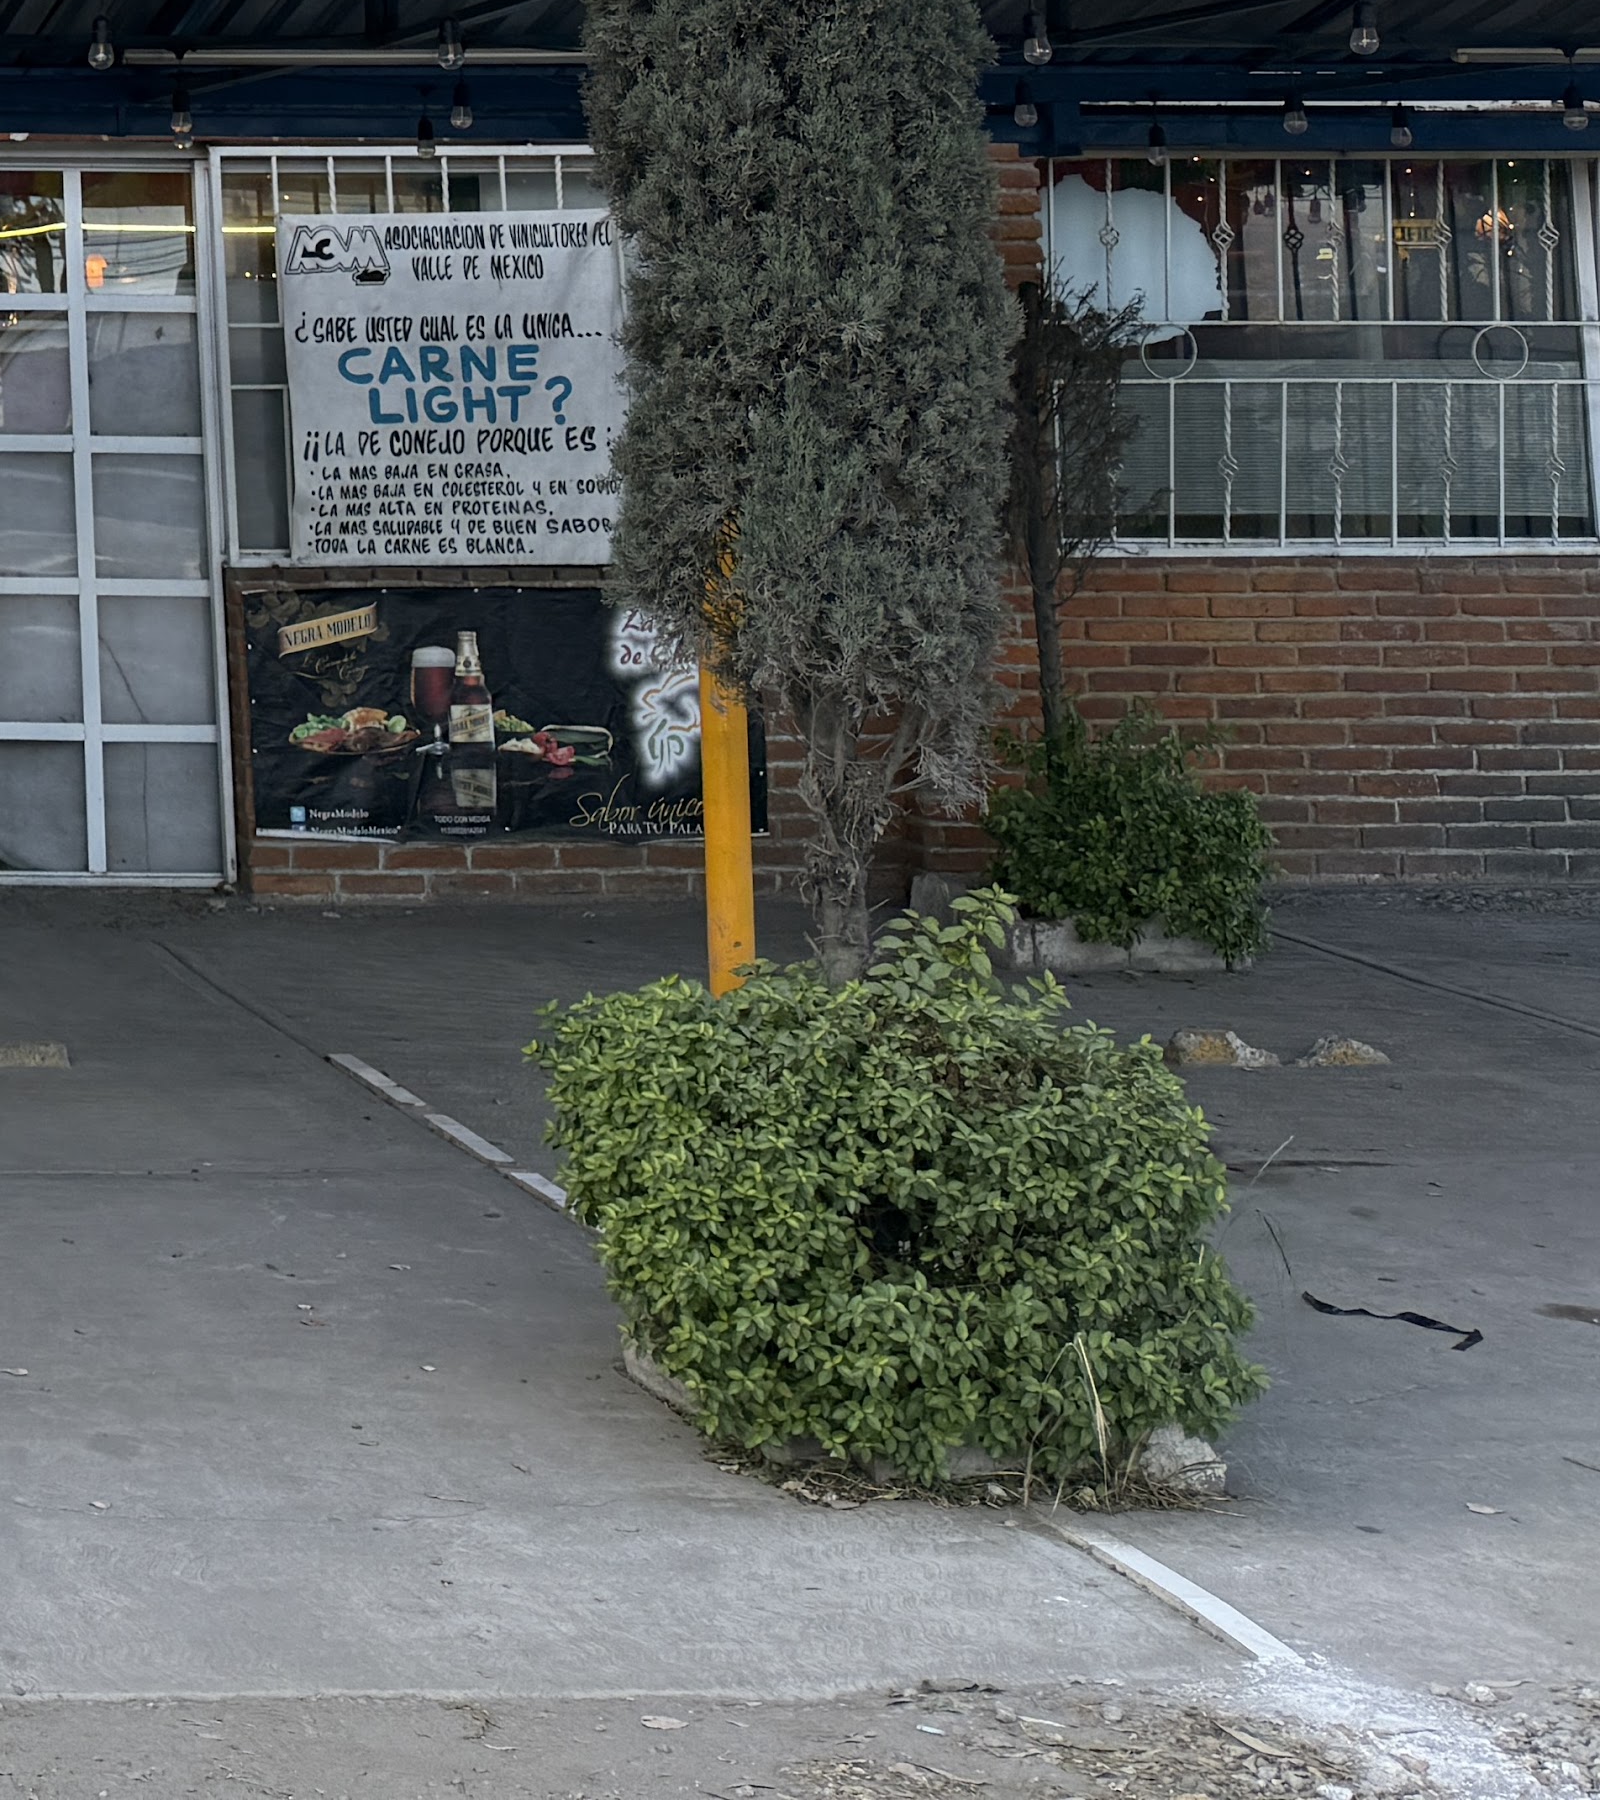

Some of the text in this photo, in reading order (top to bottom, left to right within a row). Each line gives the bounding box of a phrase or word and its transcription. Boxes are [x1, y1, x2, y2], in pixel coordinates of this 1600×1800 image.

[490, 224, 505, 249] DE
[509, 221, 588, 249] VINICULTORES
[411, 254, 544, 281] VALLE DE MEXICO
[366, 315, 413, 342] USTED
[420, 315, 459, 342] CUAL
[466, 315, 486, 341] ES
[495, 314, 513, 340] LA
[337, 344, 540, 385] CARNE
[358, 429, 382, 457] DE
[389, 429, 466, 457] CONEJO
[477, 427, 554, 456] PORQUE
[322, 466, 342, 481] LA
[349, 464, 378, 481] MAS
[384, 463, 419, 480] BAJA
[427, 463, 448, 479] EN
[318, 485, 338, 501] LA
[340, 484, 368, 501] MAS
[373, 482, 406, 499] BAJA
[413, 482, 434, 498] EN
[442, 480, 524, 498] COLESTEROL
[549, 479, 568, 497] EN
[318, 503, 338, 519] LA
[345, 501, 371, 517] MAS
[378, 500, 416, 517] ALTA
[424, 501, 444, 517] EN
[314, 521, 333, 537] LA
[338, 520, 368, 537] MAS
[373, 519, 444, 537] SALUDABLE
[467, 519, 488, 535] DE
[494, 518, 538, 536] BUEN
[314, 539, 349, 556] TODA
[357, 539, 377, 556] LA
[384, 538, 431, 555] CARNE
[438, 537, 458, 554] ES
[284, 612, 373, 650] NEGRA MODELO
[620, 643, 643, 665] de
[570, 774, 641, 832] Sabor
[309, 807, 371, 822] NegraModelo
[609, 821, 641, 835] PARA
